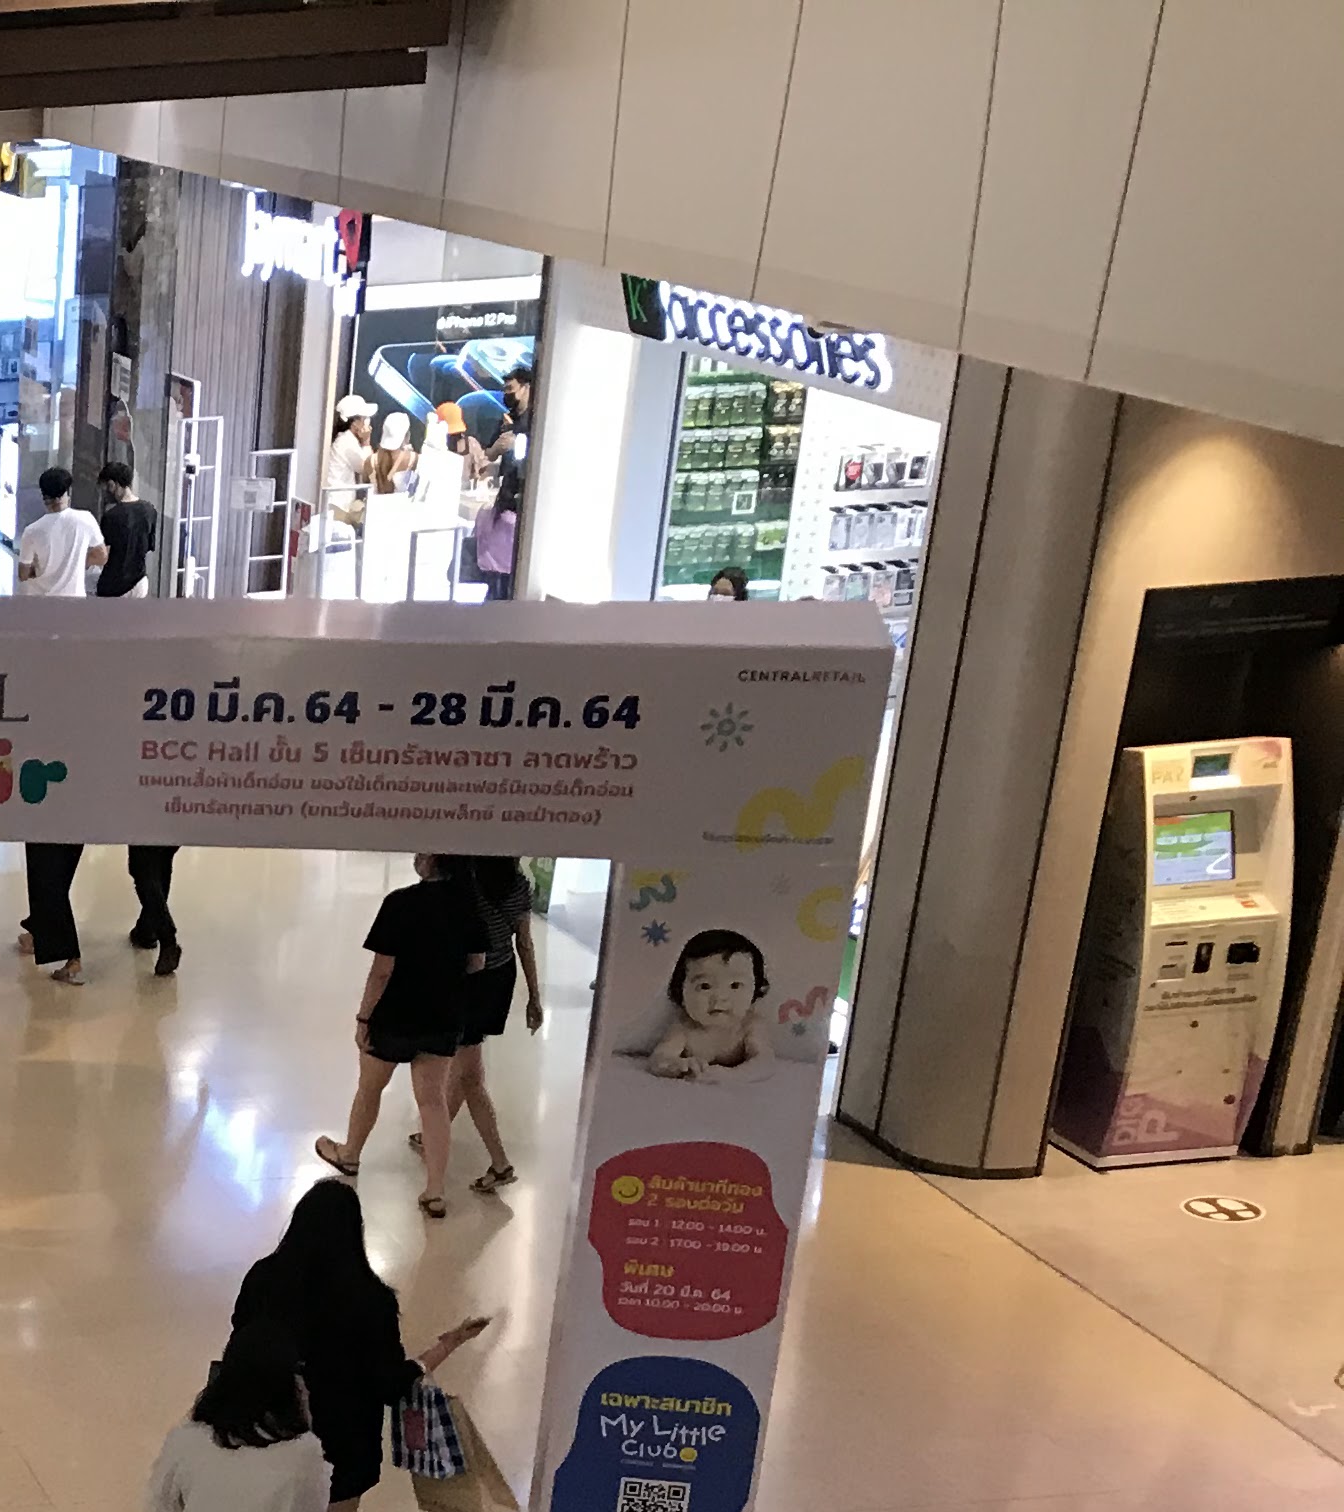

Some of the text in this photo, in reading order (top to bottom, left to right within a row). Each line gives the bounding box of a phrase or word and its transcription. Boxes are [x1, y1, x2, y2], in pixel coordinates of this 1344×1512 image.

[485, 312, 496, 326] 12
[497, 312, 517, 325] Pro
[142, 687, 195, 722] 20
[207, 676, 295, 724] มี.ค.
[305, 689, 361, 725] 64
[410, 691, 468, 726] 28
[479, 680, 572, 729] มี.ค.
[582, 694, 642, 730] 64
[140, 739, 198, 762] BCC
[208, 740, 260, 764] Hall
[312, 741, 330, 763] 5
[522, 745, 639, 771] ลาดพร้าว
[653, 1281, 675, 1297] 20
[711, 1286, 732, 1302] 64
[600, 1412, 727, 1446] My Little
[621, 1438, 678, 1458] Club
